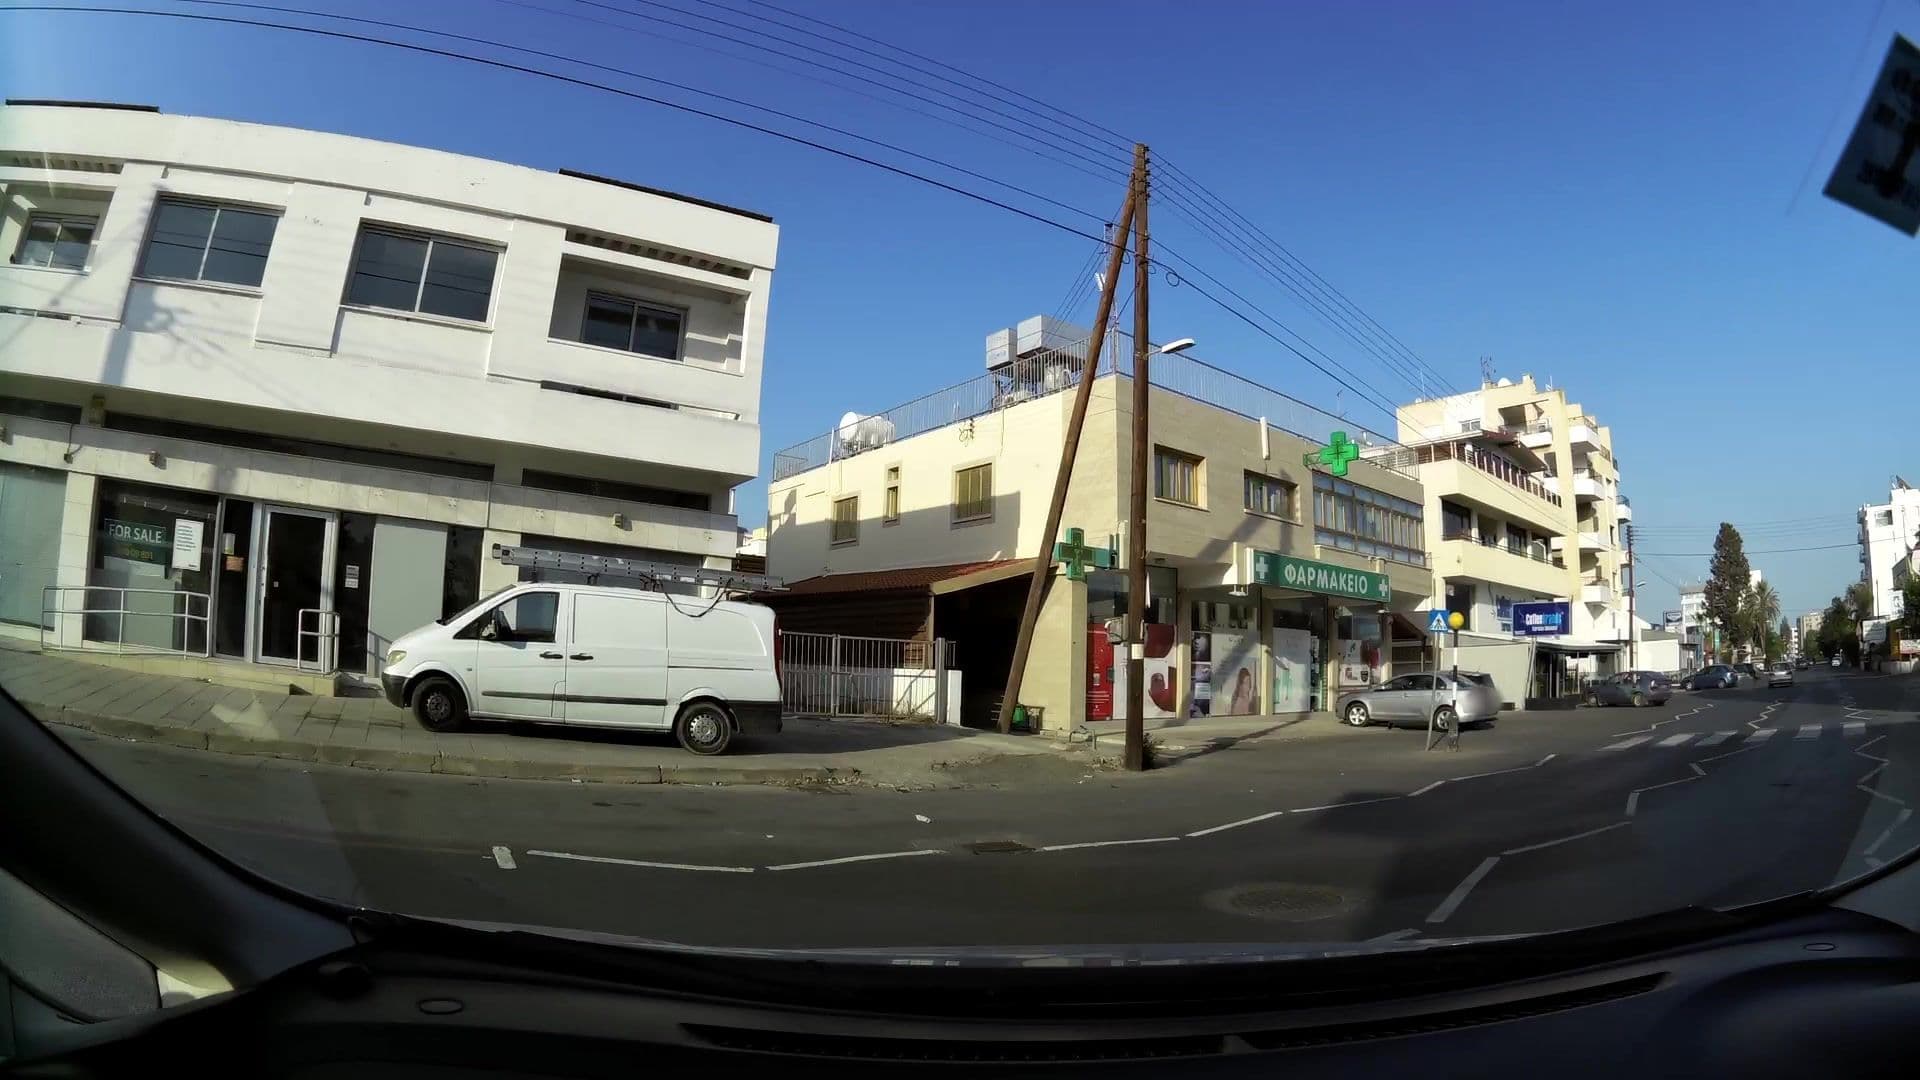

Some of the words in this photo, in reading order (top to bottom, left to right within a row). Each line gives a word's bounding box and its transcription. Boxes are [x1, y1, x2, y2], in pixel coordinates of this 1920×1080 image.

[109, 524, 132, 540] FOR
[133, 527, 162, 544] SALE
[1284, 564, 1368, 594] ΦΑΡΜΑΚΕΙΟ
